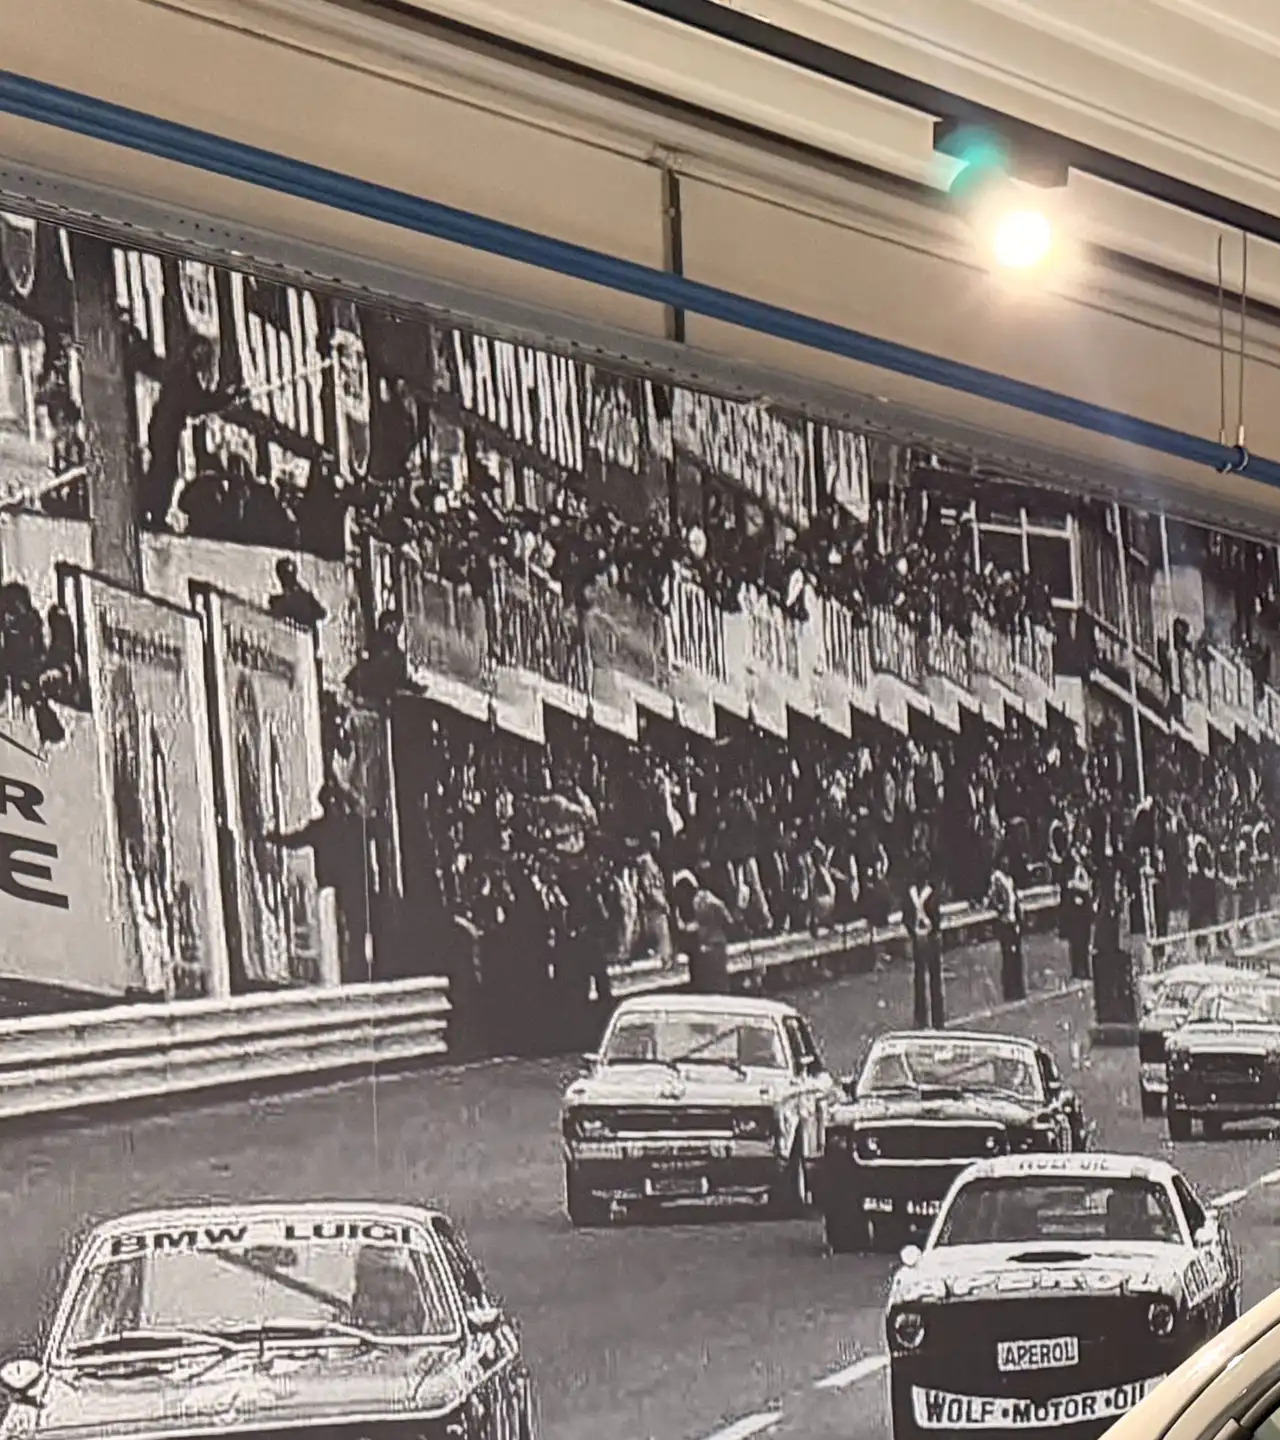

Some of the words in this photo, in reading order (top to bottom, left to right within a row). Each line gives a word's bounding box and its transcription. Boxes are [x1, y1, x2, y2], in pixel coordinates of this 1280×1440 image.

[110, 1226, 248, 1257] BMW
[284, 1222, 415, 1245] LUIGI
[1002, 1340, 1076, 1367] APEROL
[924, 1390, 997, 1426] WOLF
[1012, 1395, 1098, 1424] MOTOR
